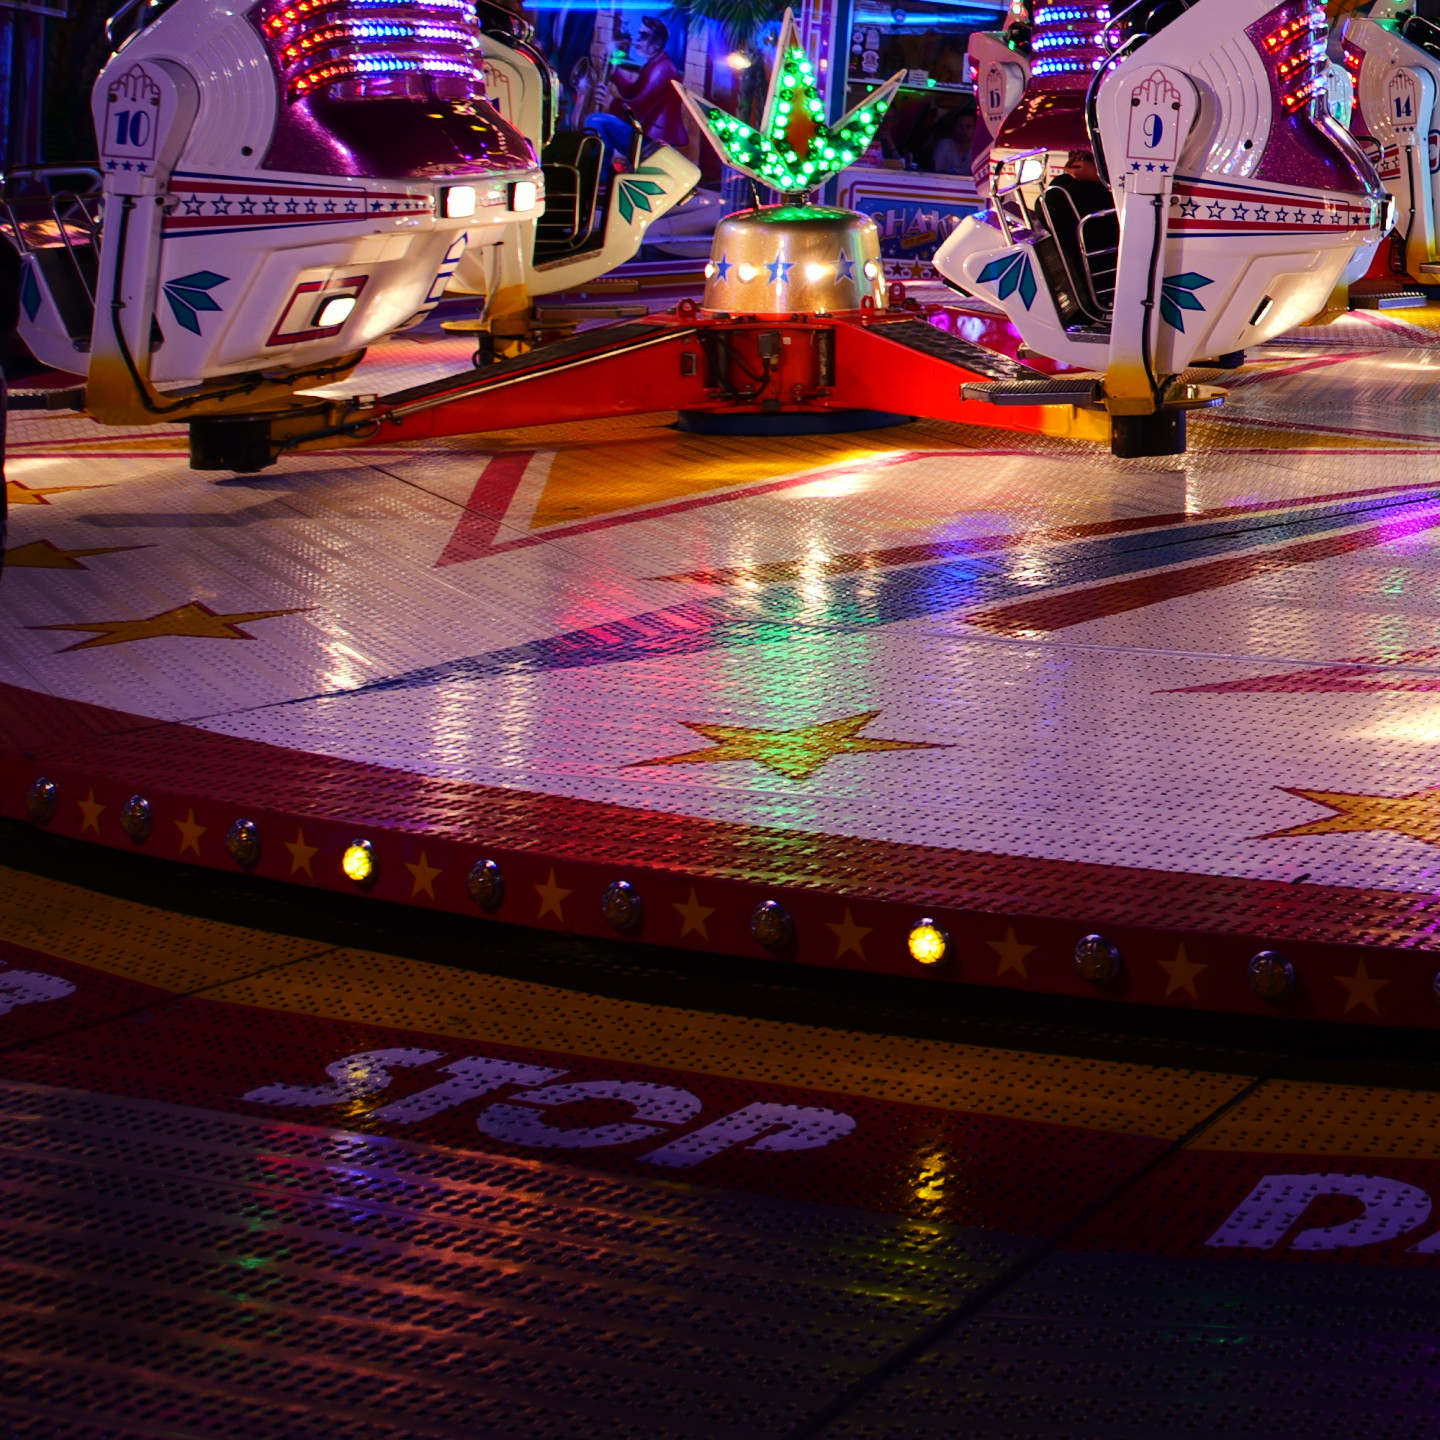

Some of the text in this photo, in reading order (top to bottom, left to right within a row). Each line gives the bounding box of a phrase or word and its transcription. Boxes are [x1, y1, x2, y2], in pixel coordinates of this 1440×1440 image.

[1394, 95, 1413, 118] 14
[113, 110, 151, 148] 10
[1143, 113, 1164, 148] 9
[238, 1044, 858, 1169] STOP
